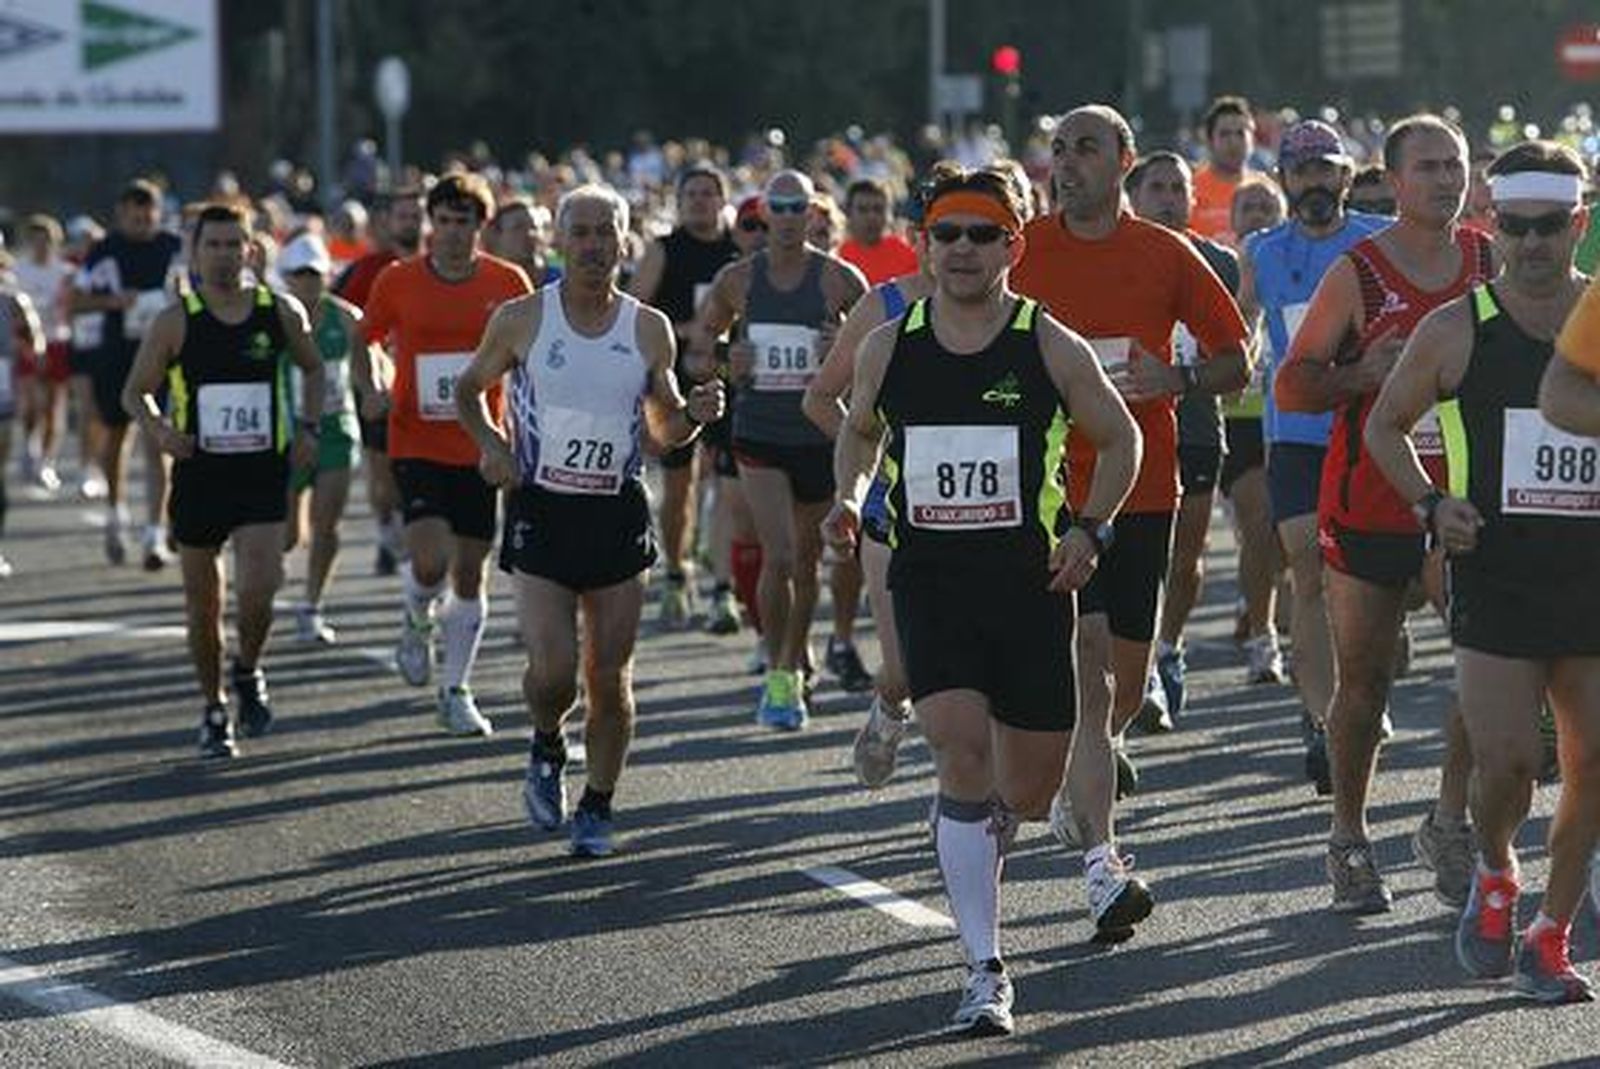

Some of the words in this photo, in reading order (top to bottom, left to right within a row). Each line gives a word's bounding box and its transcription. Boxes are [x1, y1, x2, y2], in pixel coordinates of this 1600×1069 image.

[768, 346, 807, 370] 618
[220, 407, 259, 432] 794
[564, 439, 613, 470] 278
[1535, 444, 1597, 484] 988
[936, 460, 999, 499] 878
